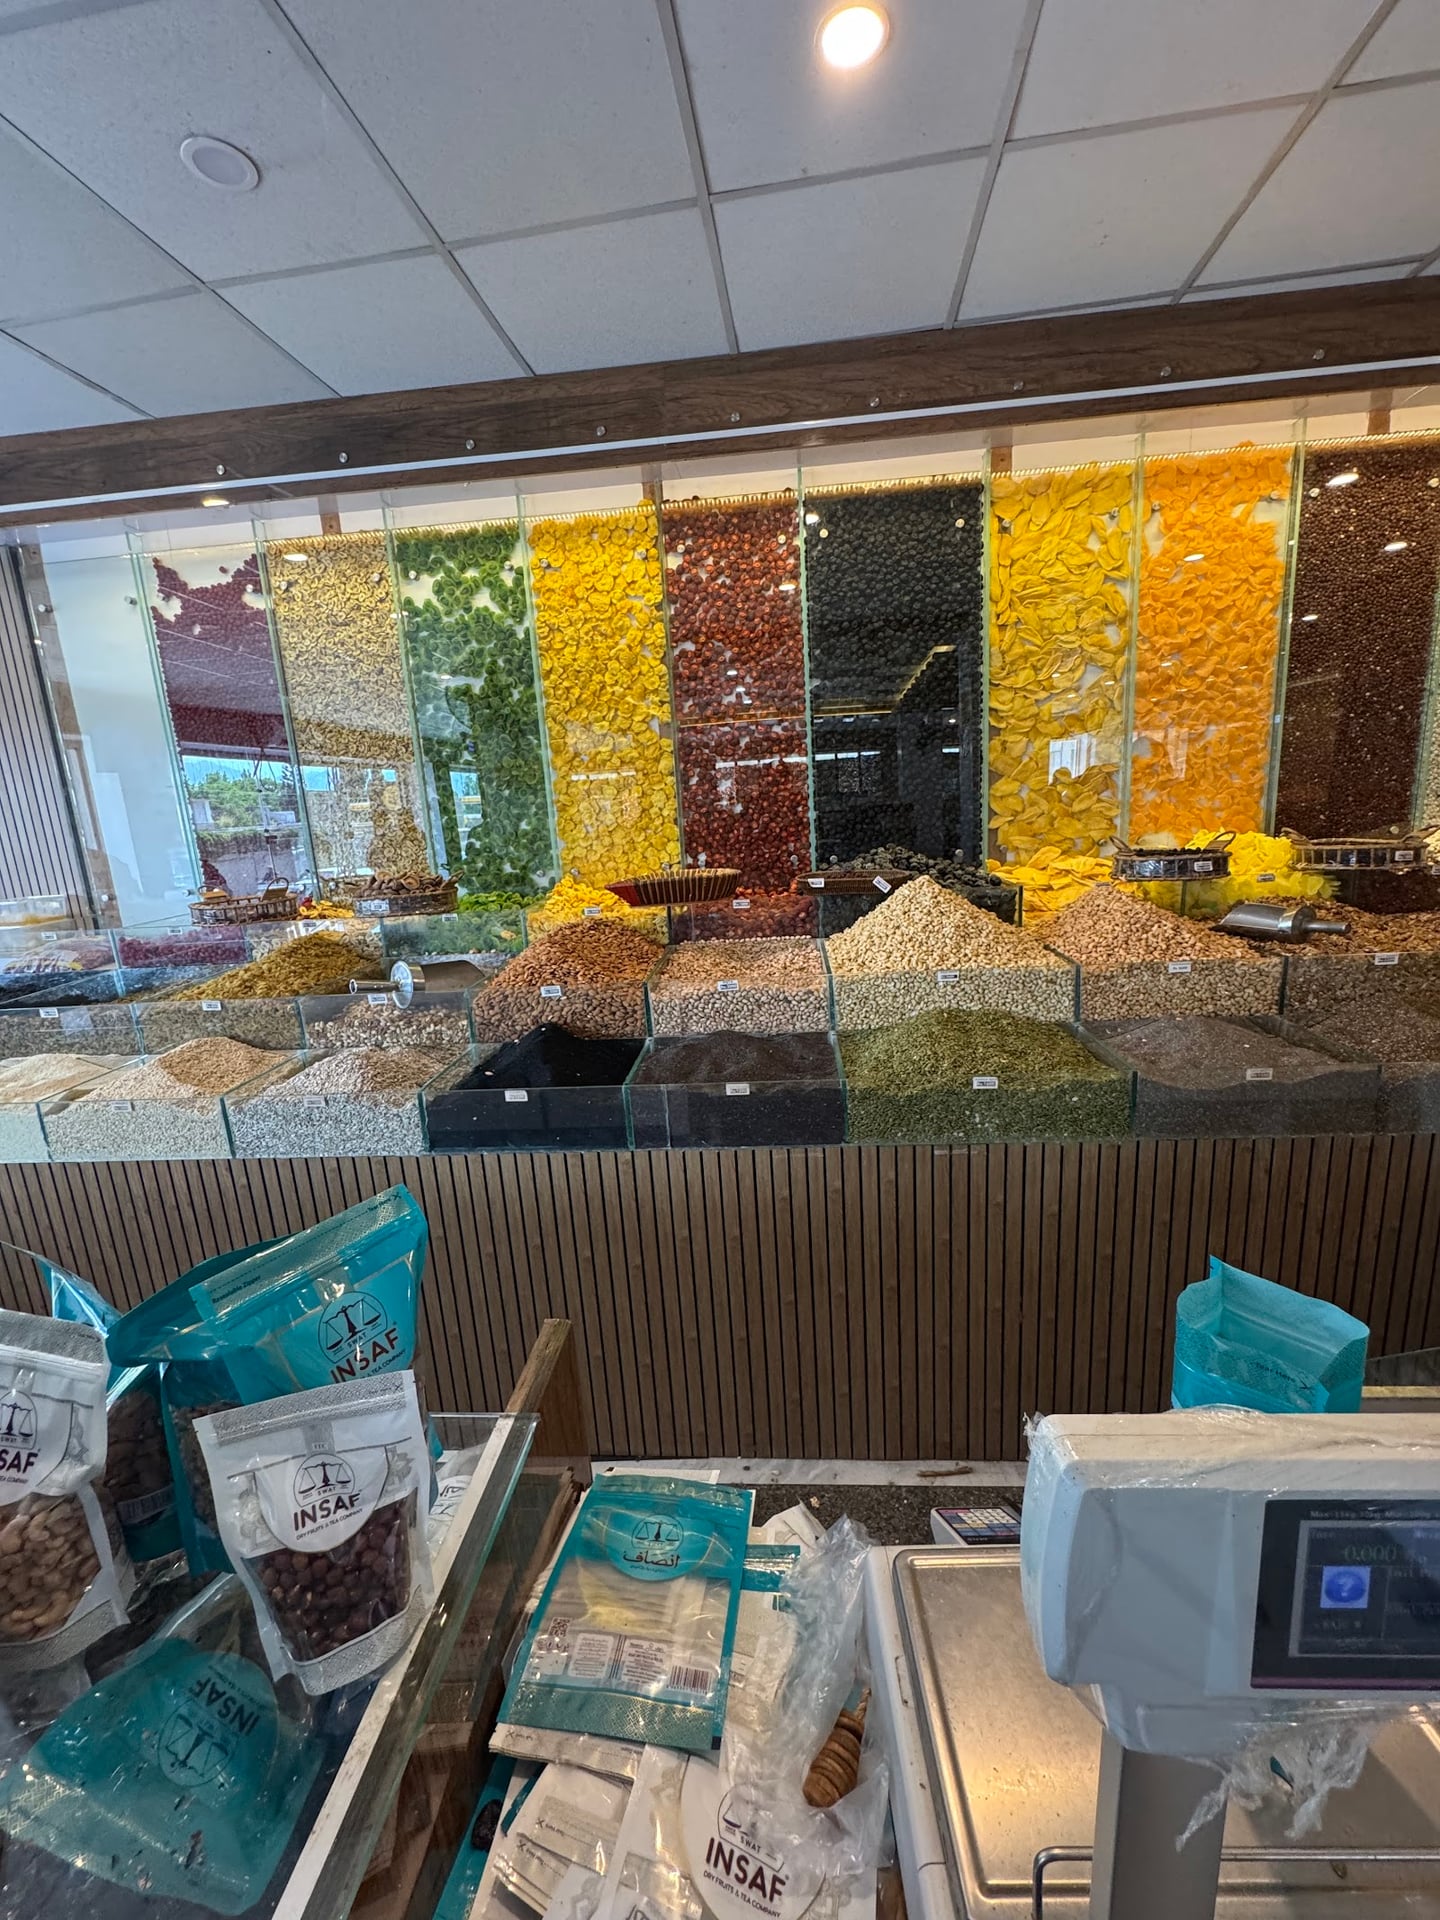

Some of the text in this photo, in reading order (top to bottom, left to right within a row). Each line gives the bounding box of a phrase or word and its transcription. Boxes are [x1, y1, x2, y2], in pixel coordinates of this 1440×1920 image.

[330, 1327, 398, 1383] INSAF
[346, 1332, 367, 1348] SWAT
[0, 1448, 39, 1474] SAF
[317, 1486, 337, 1496] SWAT
[293, 1492, 361, 1531] INSAF
[188, 1677, 261, 1737] INSAF
[740, 1836, 761, 1853] SWAT
[705, 1837, 786, 1903] INSAF
[703, 1870, 715, 1882] DRY
[715, 1877, 735, 1894] FRUITS
[740, 1892, 751, 1905] TEA
[751, 1898, 781, 1918] COMPANY
